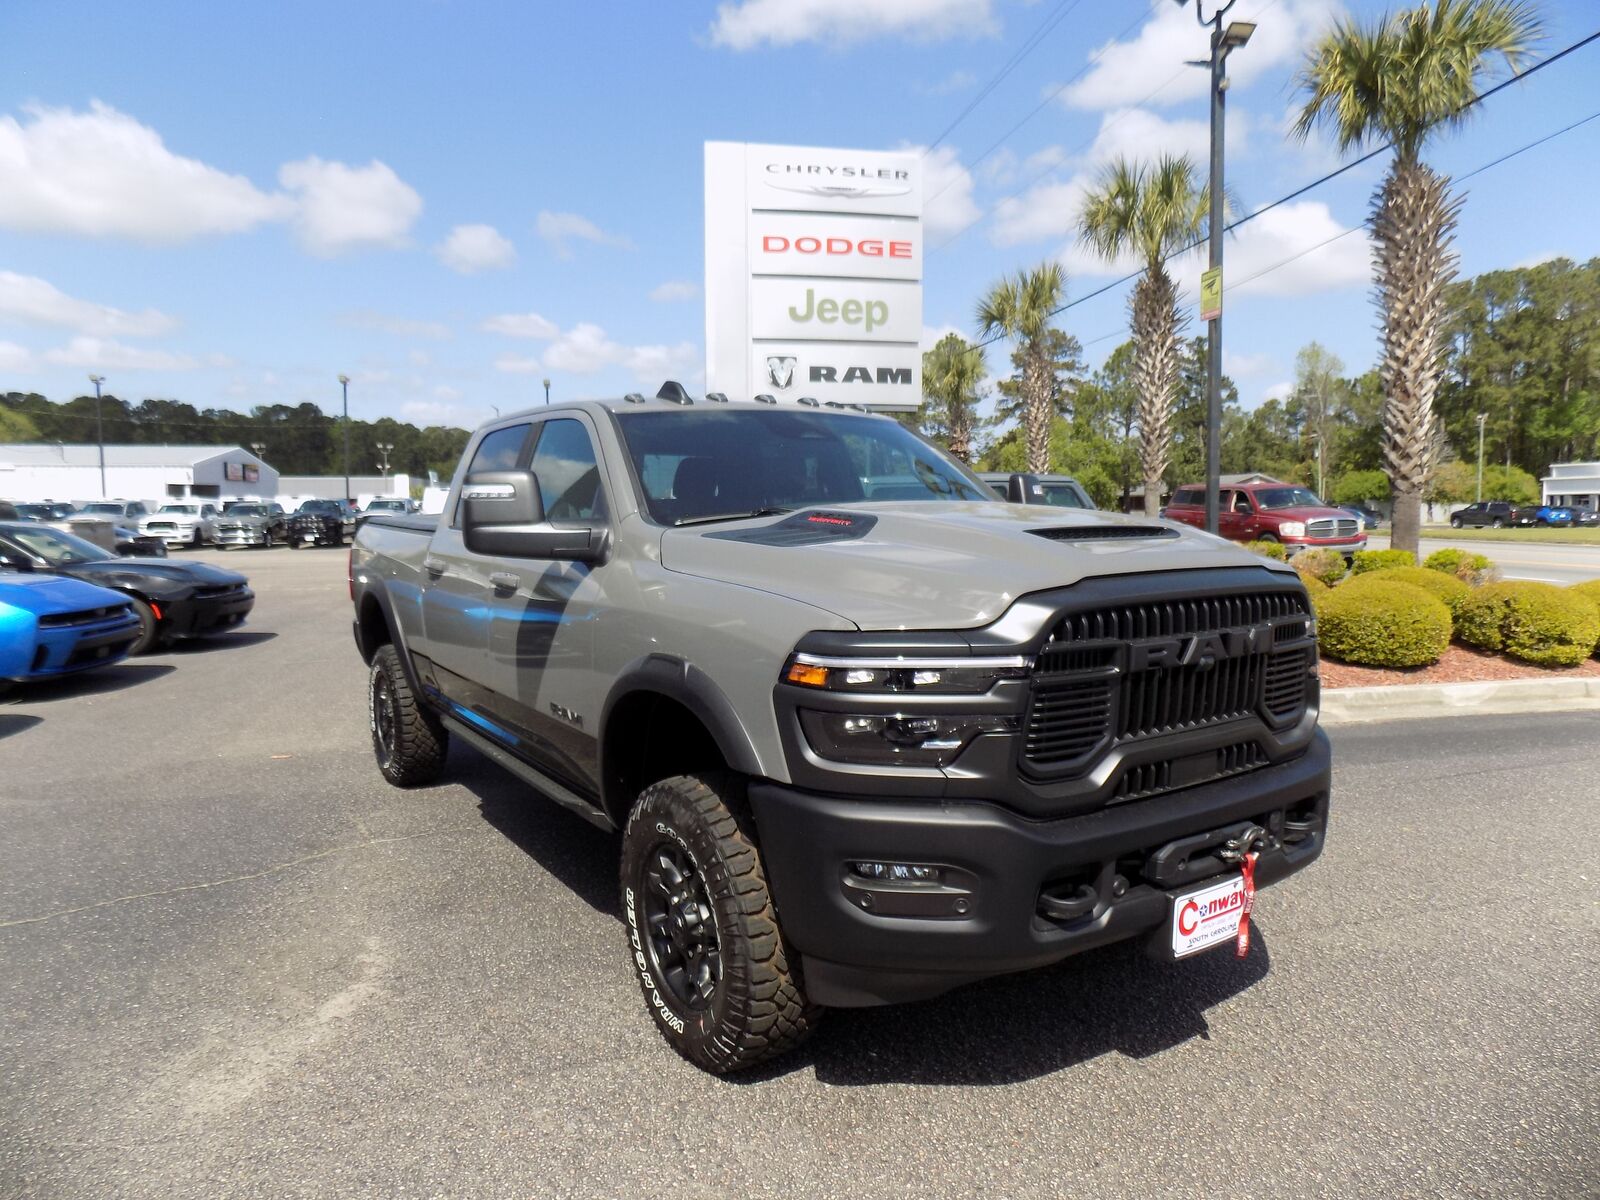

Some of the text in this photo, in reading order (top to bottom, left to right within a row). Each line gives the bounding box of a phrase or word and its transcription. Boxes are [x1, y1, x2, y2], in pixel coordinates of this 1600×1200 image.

[766, 163, 909, 181] CHRYSLER
[762, 235, 912, 260] DODGE
[788, 288, 889, 332] Jeep
[808, 365, 912, 385] RAM
[1129, 623, 1274, 673] RAM
[1178, 888, 1246, 936] Conway
[1188, 921, 1238, 945] SOUTH CAROLINA
[626, 886, 685, 1034] WRANGLER
